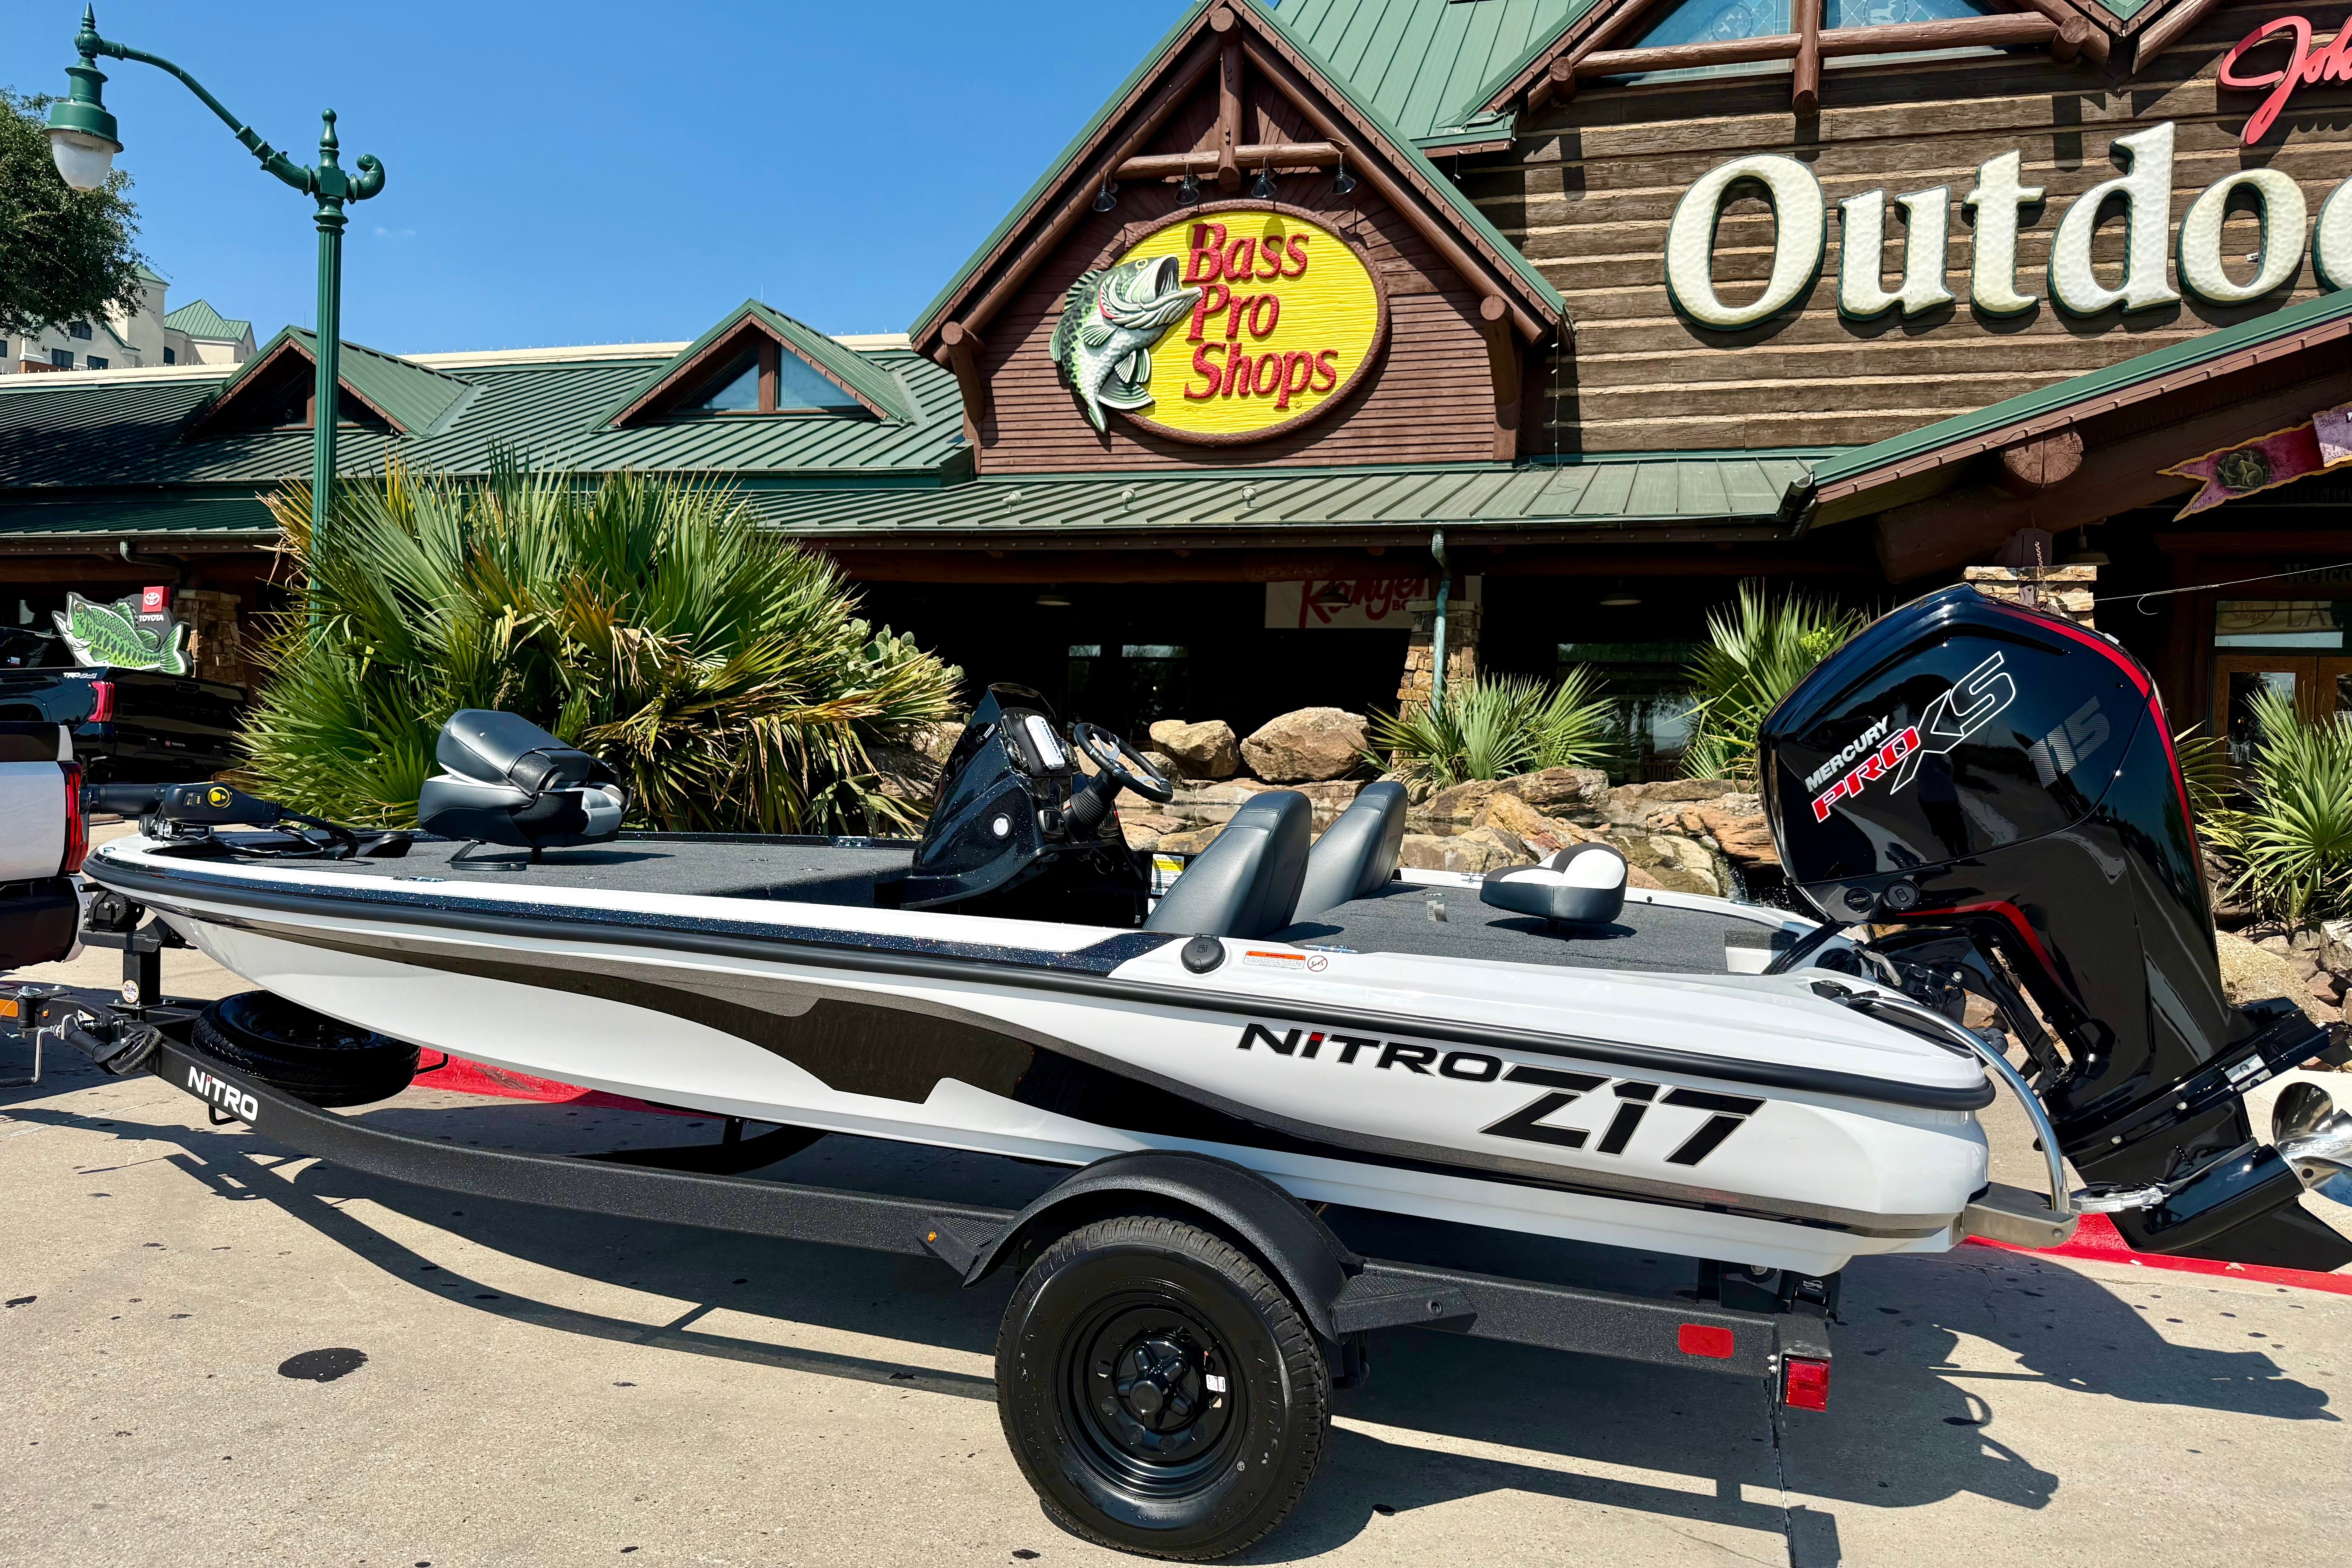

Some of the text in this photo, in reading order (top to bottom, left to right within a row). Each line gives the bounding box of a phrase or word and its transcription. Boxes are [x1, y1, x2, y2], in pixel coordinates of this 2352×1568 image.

[1181, 223, 1309, 283] Bass
[1185, 284, 1280, 341] Pro
[1183, 342, 1338, 409] Shops
[1805, 715, 1889, 793] MERCURY
[2028, 695, 2110, 789] 115
[1236, 1022, 1503, 1083] NITRO
[188, 1066, 259, 1121] NITRO
